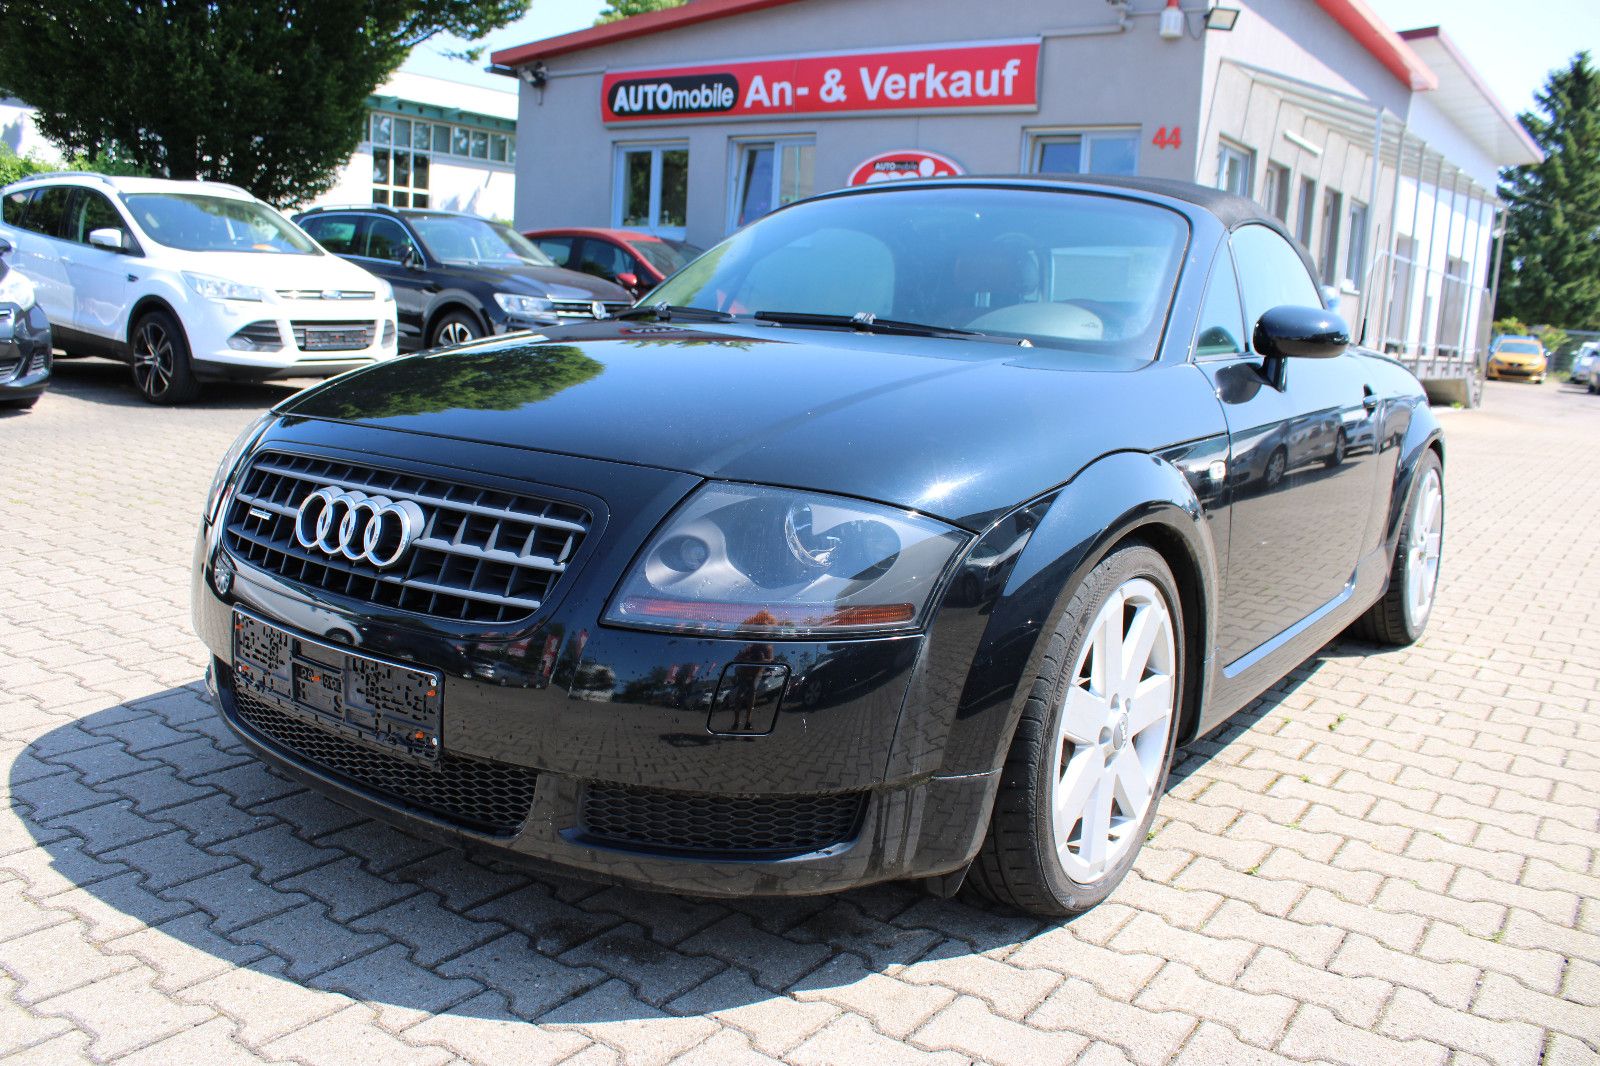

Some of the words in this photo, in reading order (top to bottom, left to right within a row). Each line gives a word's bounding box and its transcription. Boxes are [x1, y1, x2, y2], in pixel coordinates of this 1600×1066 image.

[612, 82, 735, 113] AUTOmobile
[744, 75, 810, 109] An-
[818, 68, 848, 104] &
[858, 58, 1022, 102] Verkauf
[1152, 126, 1182, 150] 44
